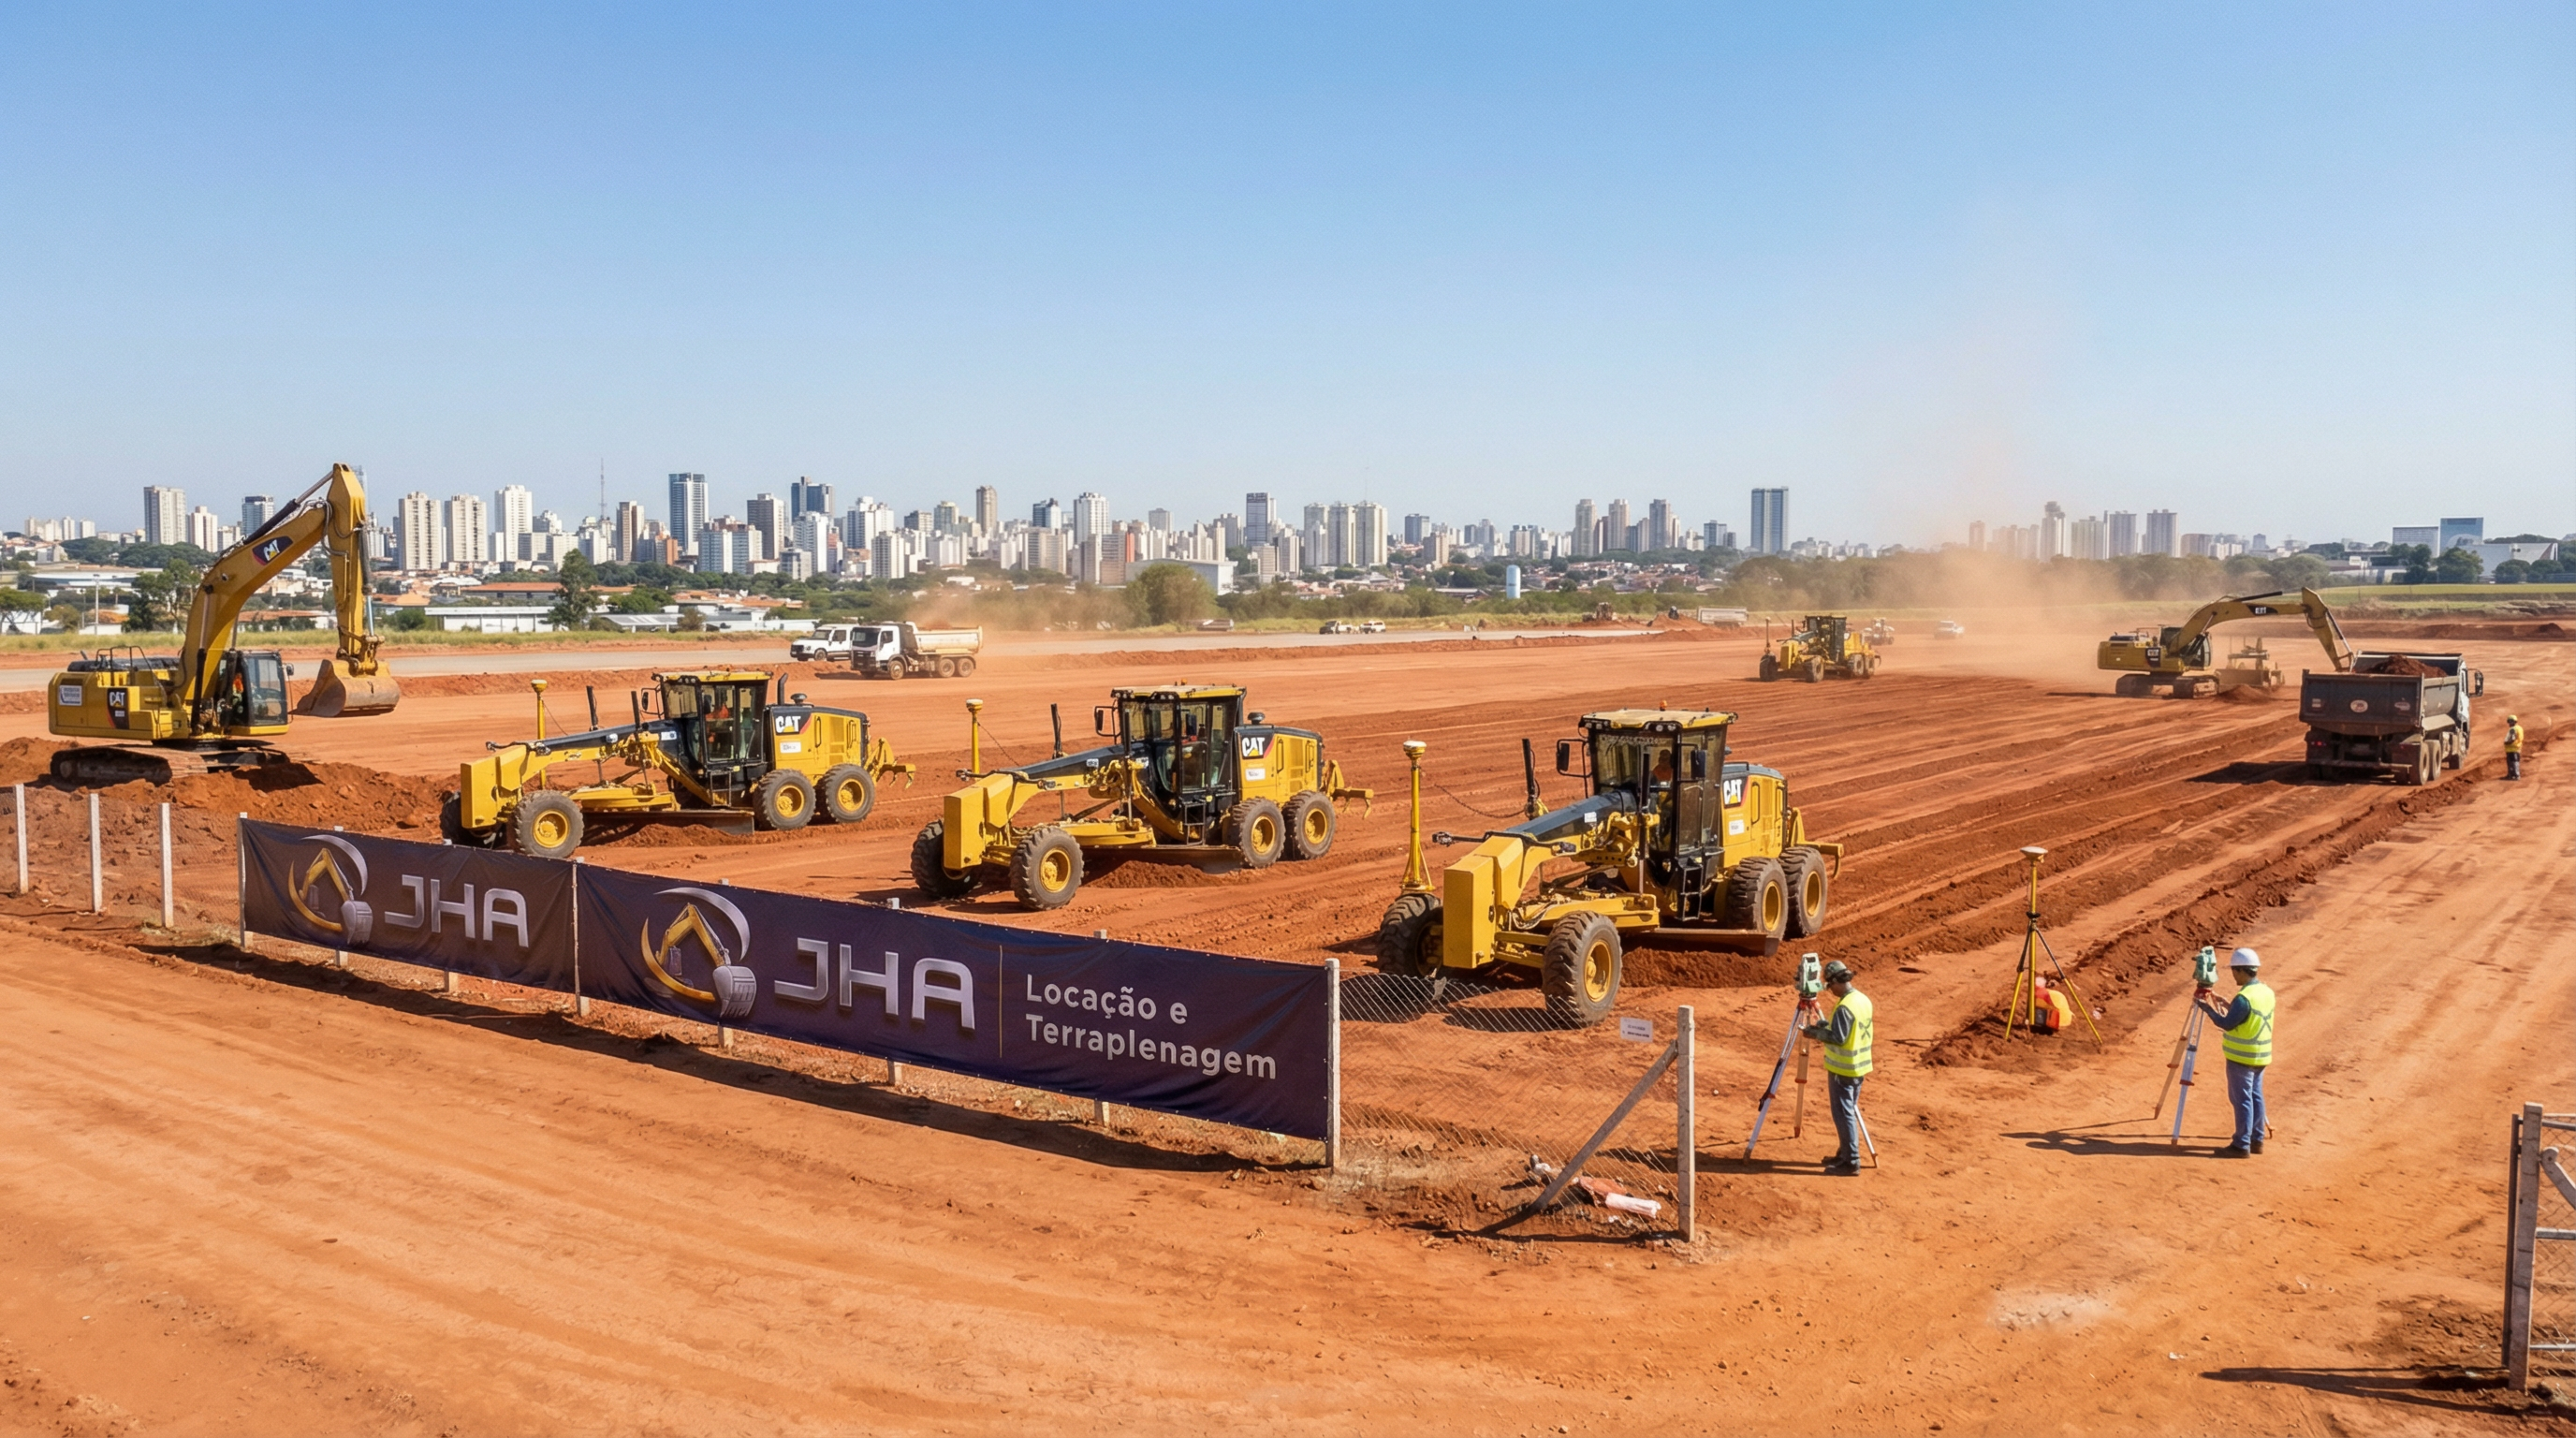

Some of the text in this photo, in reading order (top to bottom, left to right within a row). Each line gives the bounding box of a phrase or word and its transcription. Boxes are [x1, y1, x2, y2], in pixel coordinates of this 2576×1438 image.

[109, 691, 125, 708] CAT
[775, 715, 801, 733] CAT
[1241, 737, 1266, 757] CAT
[1723, 778, 1743, 805] CAT
[384, 873, 529, 948] JHA
[774, 937, 975, 1030] JHA
[1027, 974, 1188, 1024] Locação e
[1025, 1013, 1277, 1079] Terraplenagem
